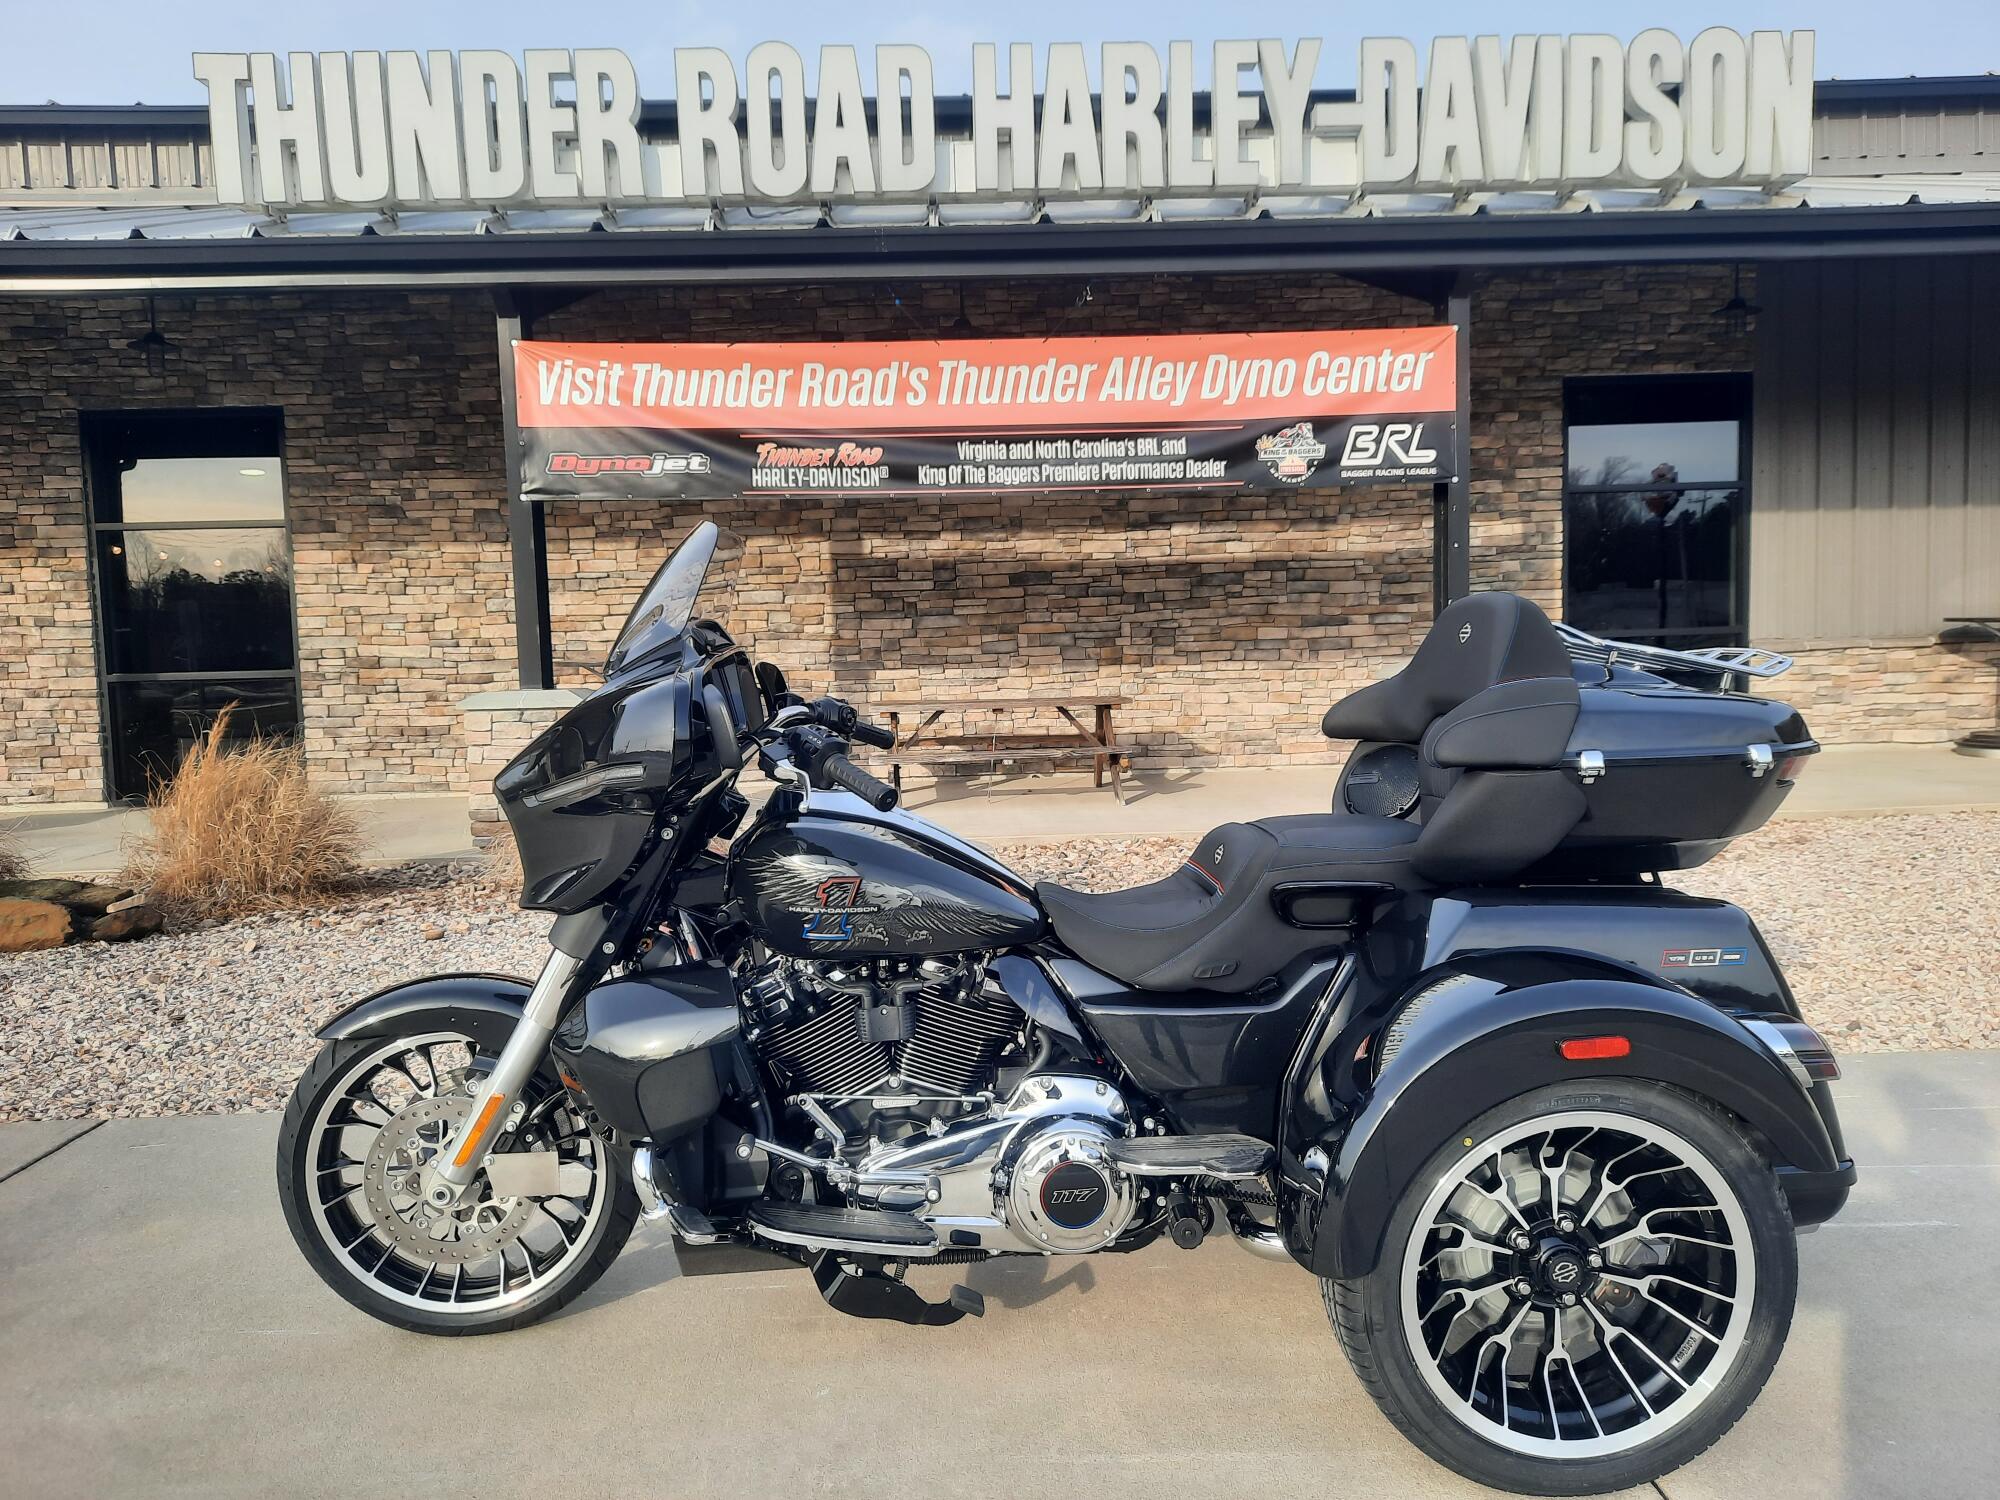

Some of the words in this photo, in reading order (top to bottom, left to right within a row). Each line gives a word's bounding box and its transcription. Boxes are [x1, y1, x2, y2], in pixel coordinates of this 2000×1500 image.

[193, 47, 645, 204] THUNDER
[675, 40, 938, 198] ROAD
[972, 26, 1816, 190] HARLEY-DAVIDSON
[537, 359, 621, 406] Visit
[631, 361, 795, 408] Thunder
[797, 361, 928, 408] Road's
[935, 357, 1098, 406] Thunder
[1099, 355, 1198, 407] Alley
[1200, 353, 1296, 406] Dyno
[1302, 348, 1435, 397] Center
[957, 440, 1007, 462] Virginia
[1008, 440, 1034, 460] and
[1035, 439, 1071, 459] North
[1072, 437, 1135, 459] Carolina's
[1137, 437, 1161, 456] BRL
[1162, 436, 1187, 455] and
[1287, 447, 1321, 455] BAGGERS
[1340, 422, 1438, 467] BRL
[548, 453, 710, 476] Dynojet
[917, 464, 947, 486] King
[949, 464, 963, 485] Of
[963, 465, 986, 484] The
[988, 464, 1040, 486] Baggers
[1041, 462, 1100, 482] Premiere
[1101, 460, 1184, 481] Performance
[1186, 458, 1227, 478] Dealer
[1340, 469, 1373, 478] BAGGER
[1375, 468, 1405, 477] RACING
[1406, 467, 1438, 475] LEAGUE
[788, 906, 878, 914] HARLEY-DAVIDSON
[1051, 1187, 1099, 1204] 117
